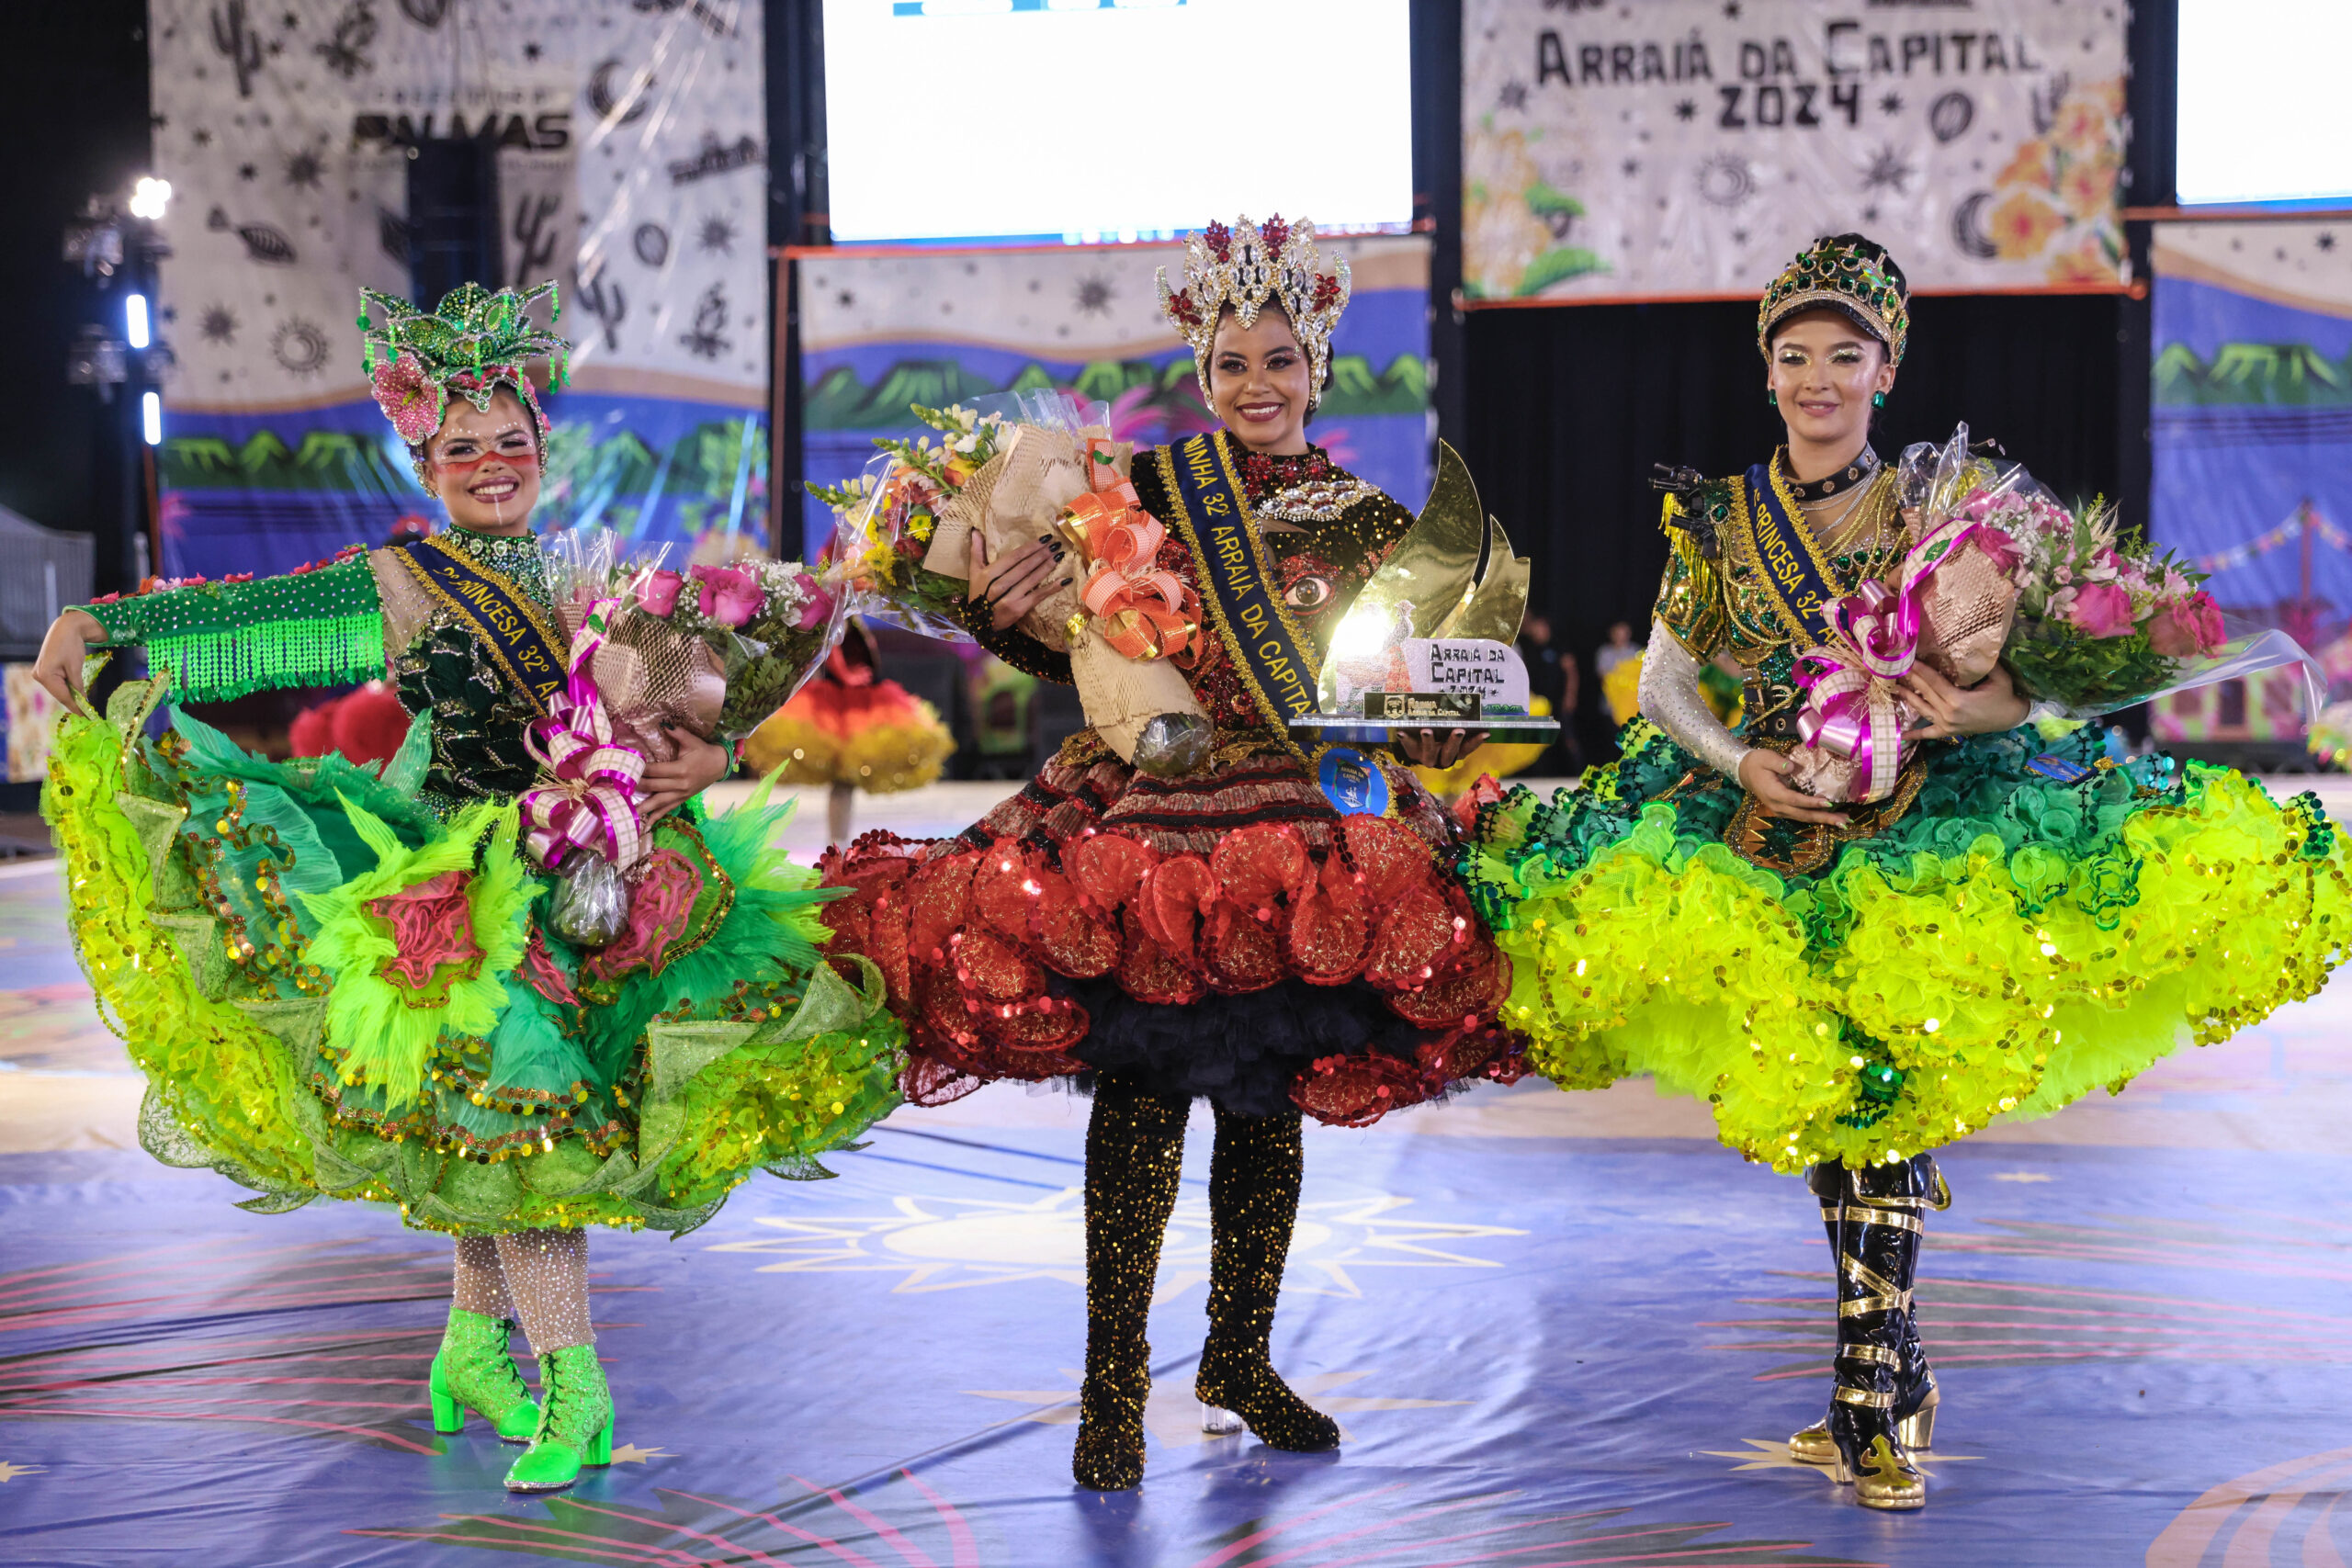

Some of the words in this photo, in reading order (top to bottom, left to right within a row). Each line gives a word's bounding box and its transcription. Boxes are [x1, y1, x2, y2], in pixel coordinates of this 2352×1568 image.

[1719, 84, 1863, 129] 2024
[1756, 502, 1805, 594] PRINCESA
[448, 581, 526, 646] PRINCESA
[1241, 604, 1269, 639] DA
[1259, 641, 1317, 718] CAPITA
[1430, 661, 1505, 684] CAPITAL
